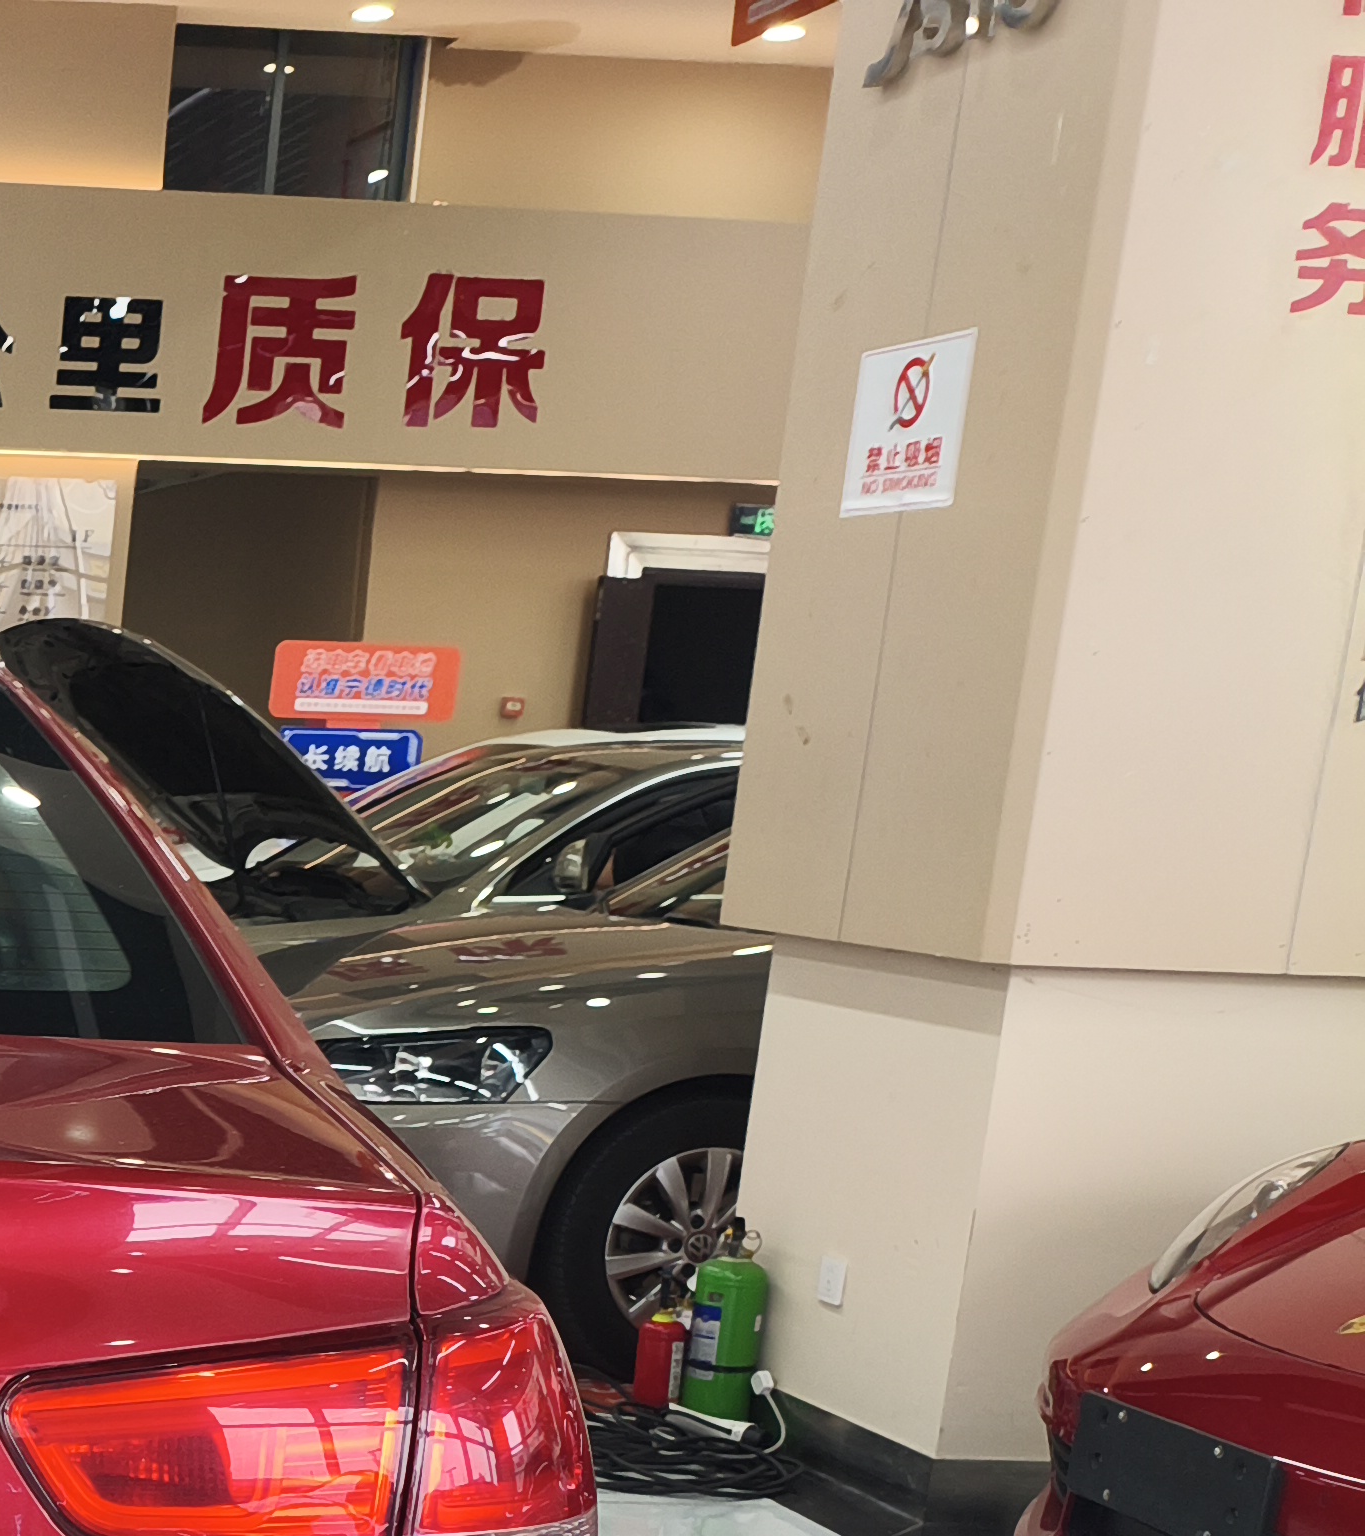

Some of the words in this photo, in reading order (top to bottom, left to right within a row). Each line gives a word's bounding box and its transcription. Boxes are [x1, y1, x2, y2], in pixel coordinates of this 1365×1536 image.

[866, 436, 943, 473] 禁止吸烟
[860, 479, 880, 495] NO
[881, 472, 938, 494] SMOKING
[303, 744, 392, 773] 长续航
